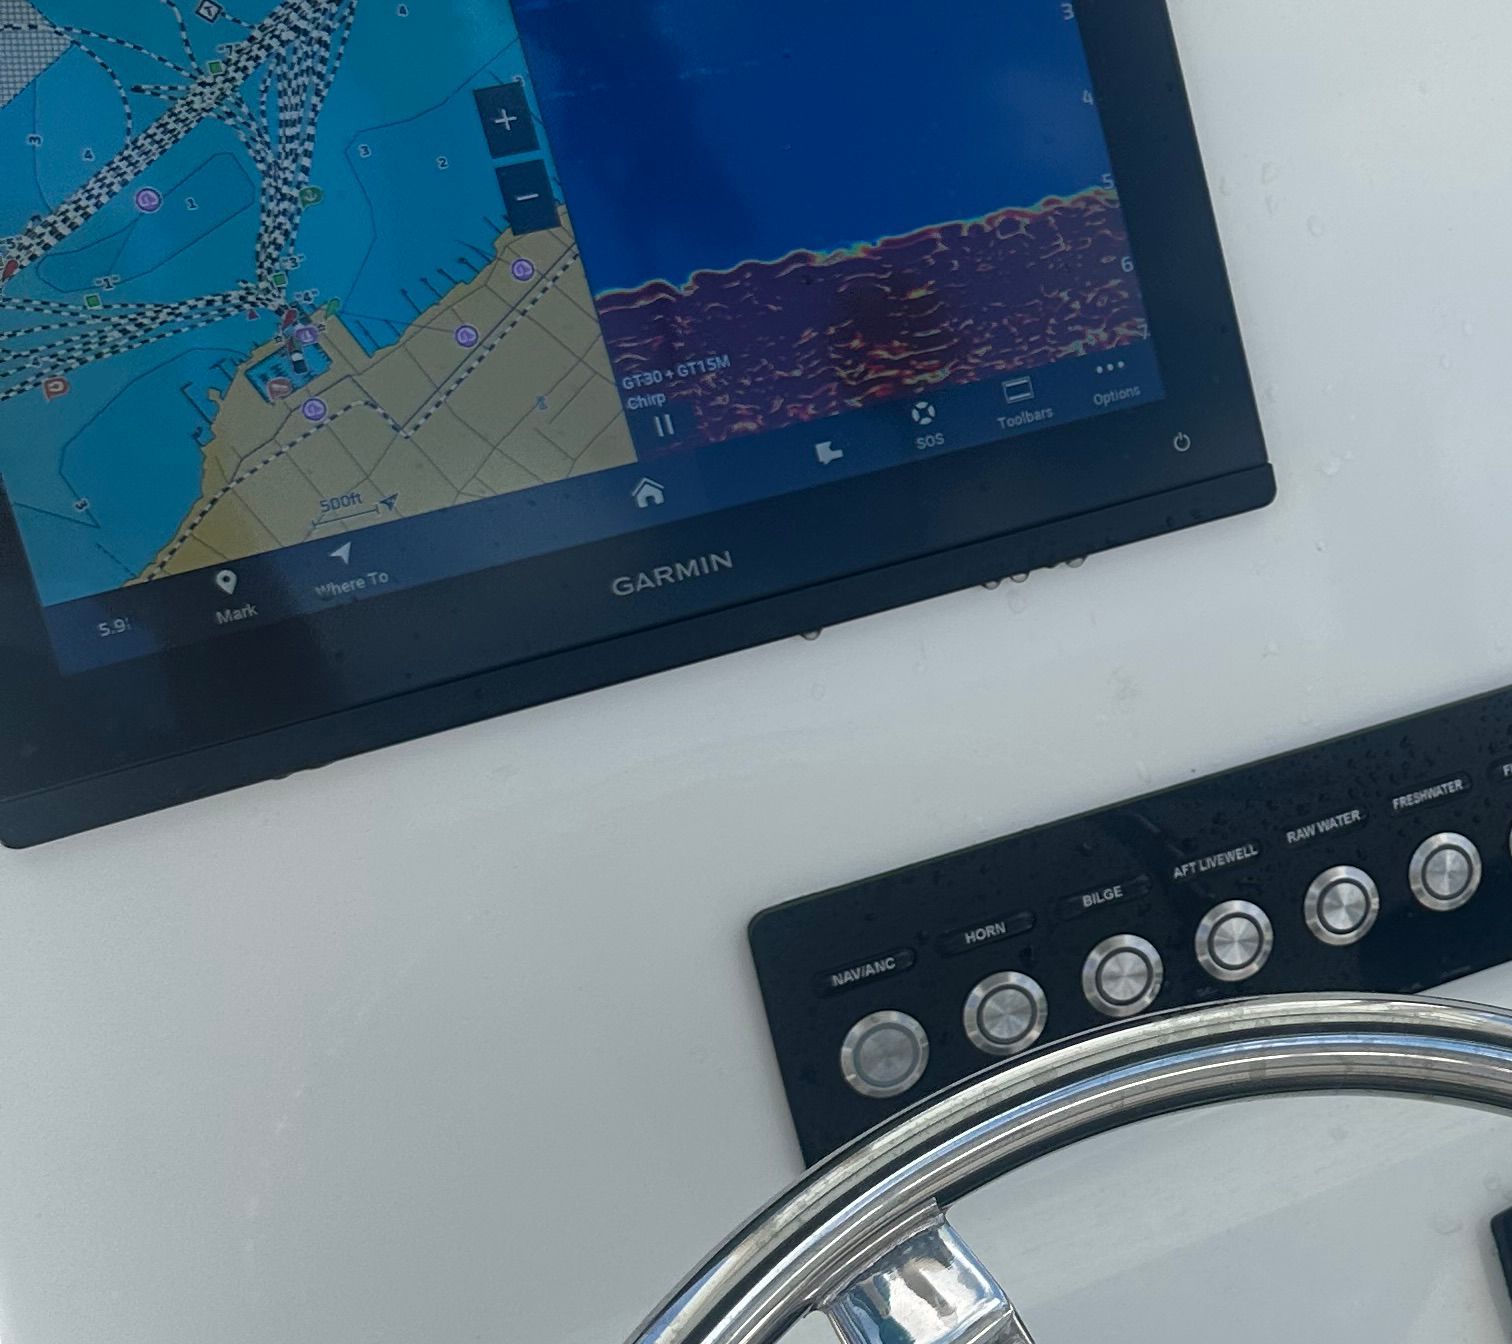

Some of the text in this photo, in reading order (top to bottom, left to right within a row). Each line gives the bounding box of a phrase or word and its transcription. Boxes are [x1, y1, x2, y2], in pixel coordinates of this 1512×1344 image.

[1061, 3, 1075, 20] 3
[1082, 89, 1095, 106] 4
[1102, 173, 1115, 189] 5
[1121, 256, 1134, 273] 6
[621, 354, 730, 390] GT30 GT15M
[627, 392, 666, 410] Chirp
[1093, 384, 1141, 407] Options
[996, 406, 1055, 430] Toolbars
[915, 432, 945, 450] SOS
[314, 570, 389, 599] Where To
[611, 550, 734, 597] GARMIN
[215, 602, 258, 625] Mark
[1392, 778, 1463, 810] FRESHWATER
[1286, 809, 1361, 844] RAW WATER
[1173, 844, 1259, 880] AFT LIVEWELL
[1082, 884, 1124, 908] BILGE
[964, 921, 1006, 945] HORN
[831, 957, 896, 987] NAV/ANC
